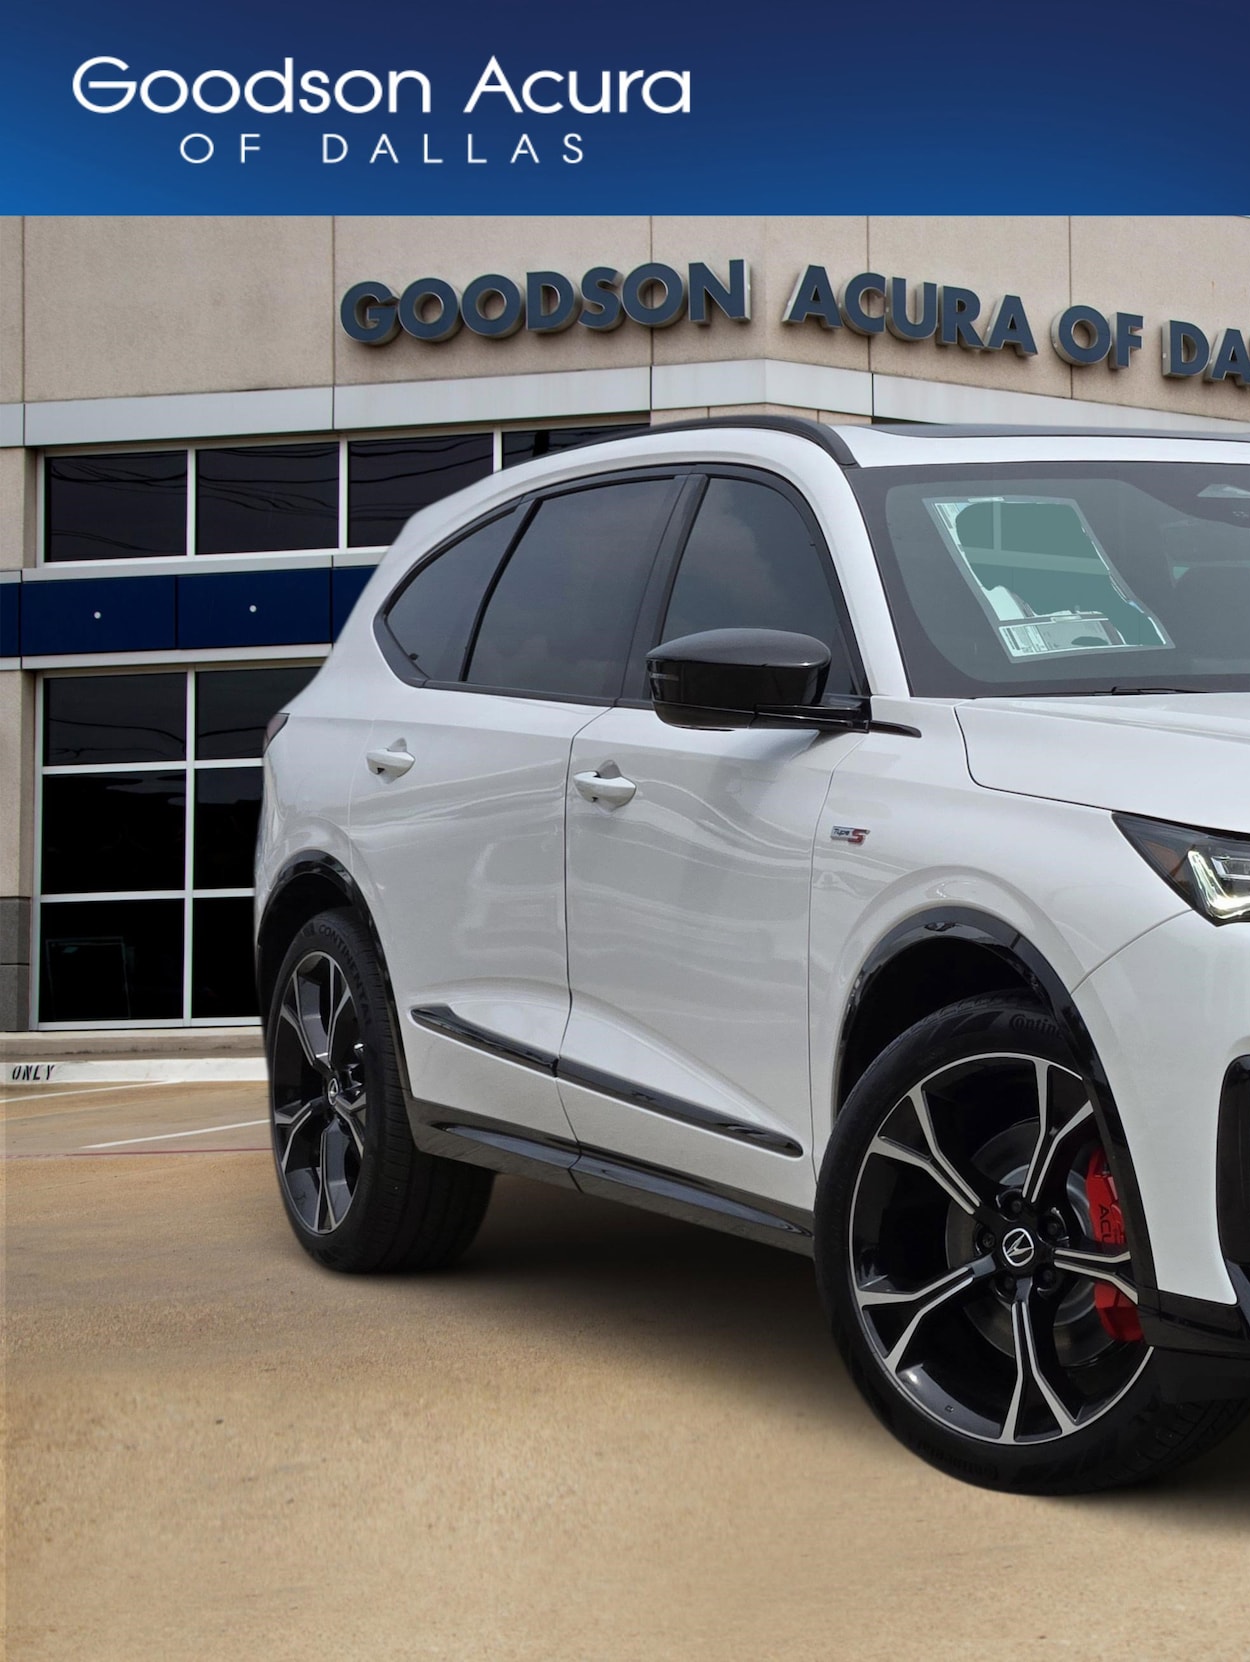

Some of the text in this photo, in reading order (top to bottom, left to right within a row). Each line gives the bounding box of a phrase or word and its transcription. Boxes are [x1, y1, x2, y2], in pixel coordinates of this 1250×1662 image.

[341, 259, 751, 348] GOODSON
[782, 264, 1038, 357] ACURA
[1051, 305, 1144, 369] OF
[12, 1064, 55, 1081] ONLY
